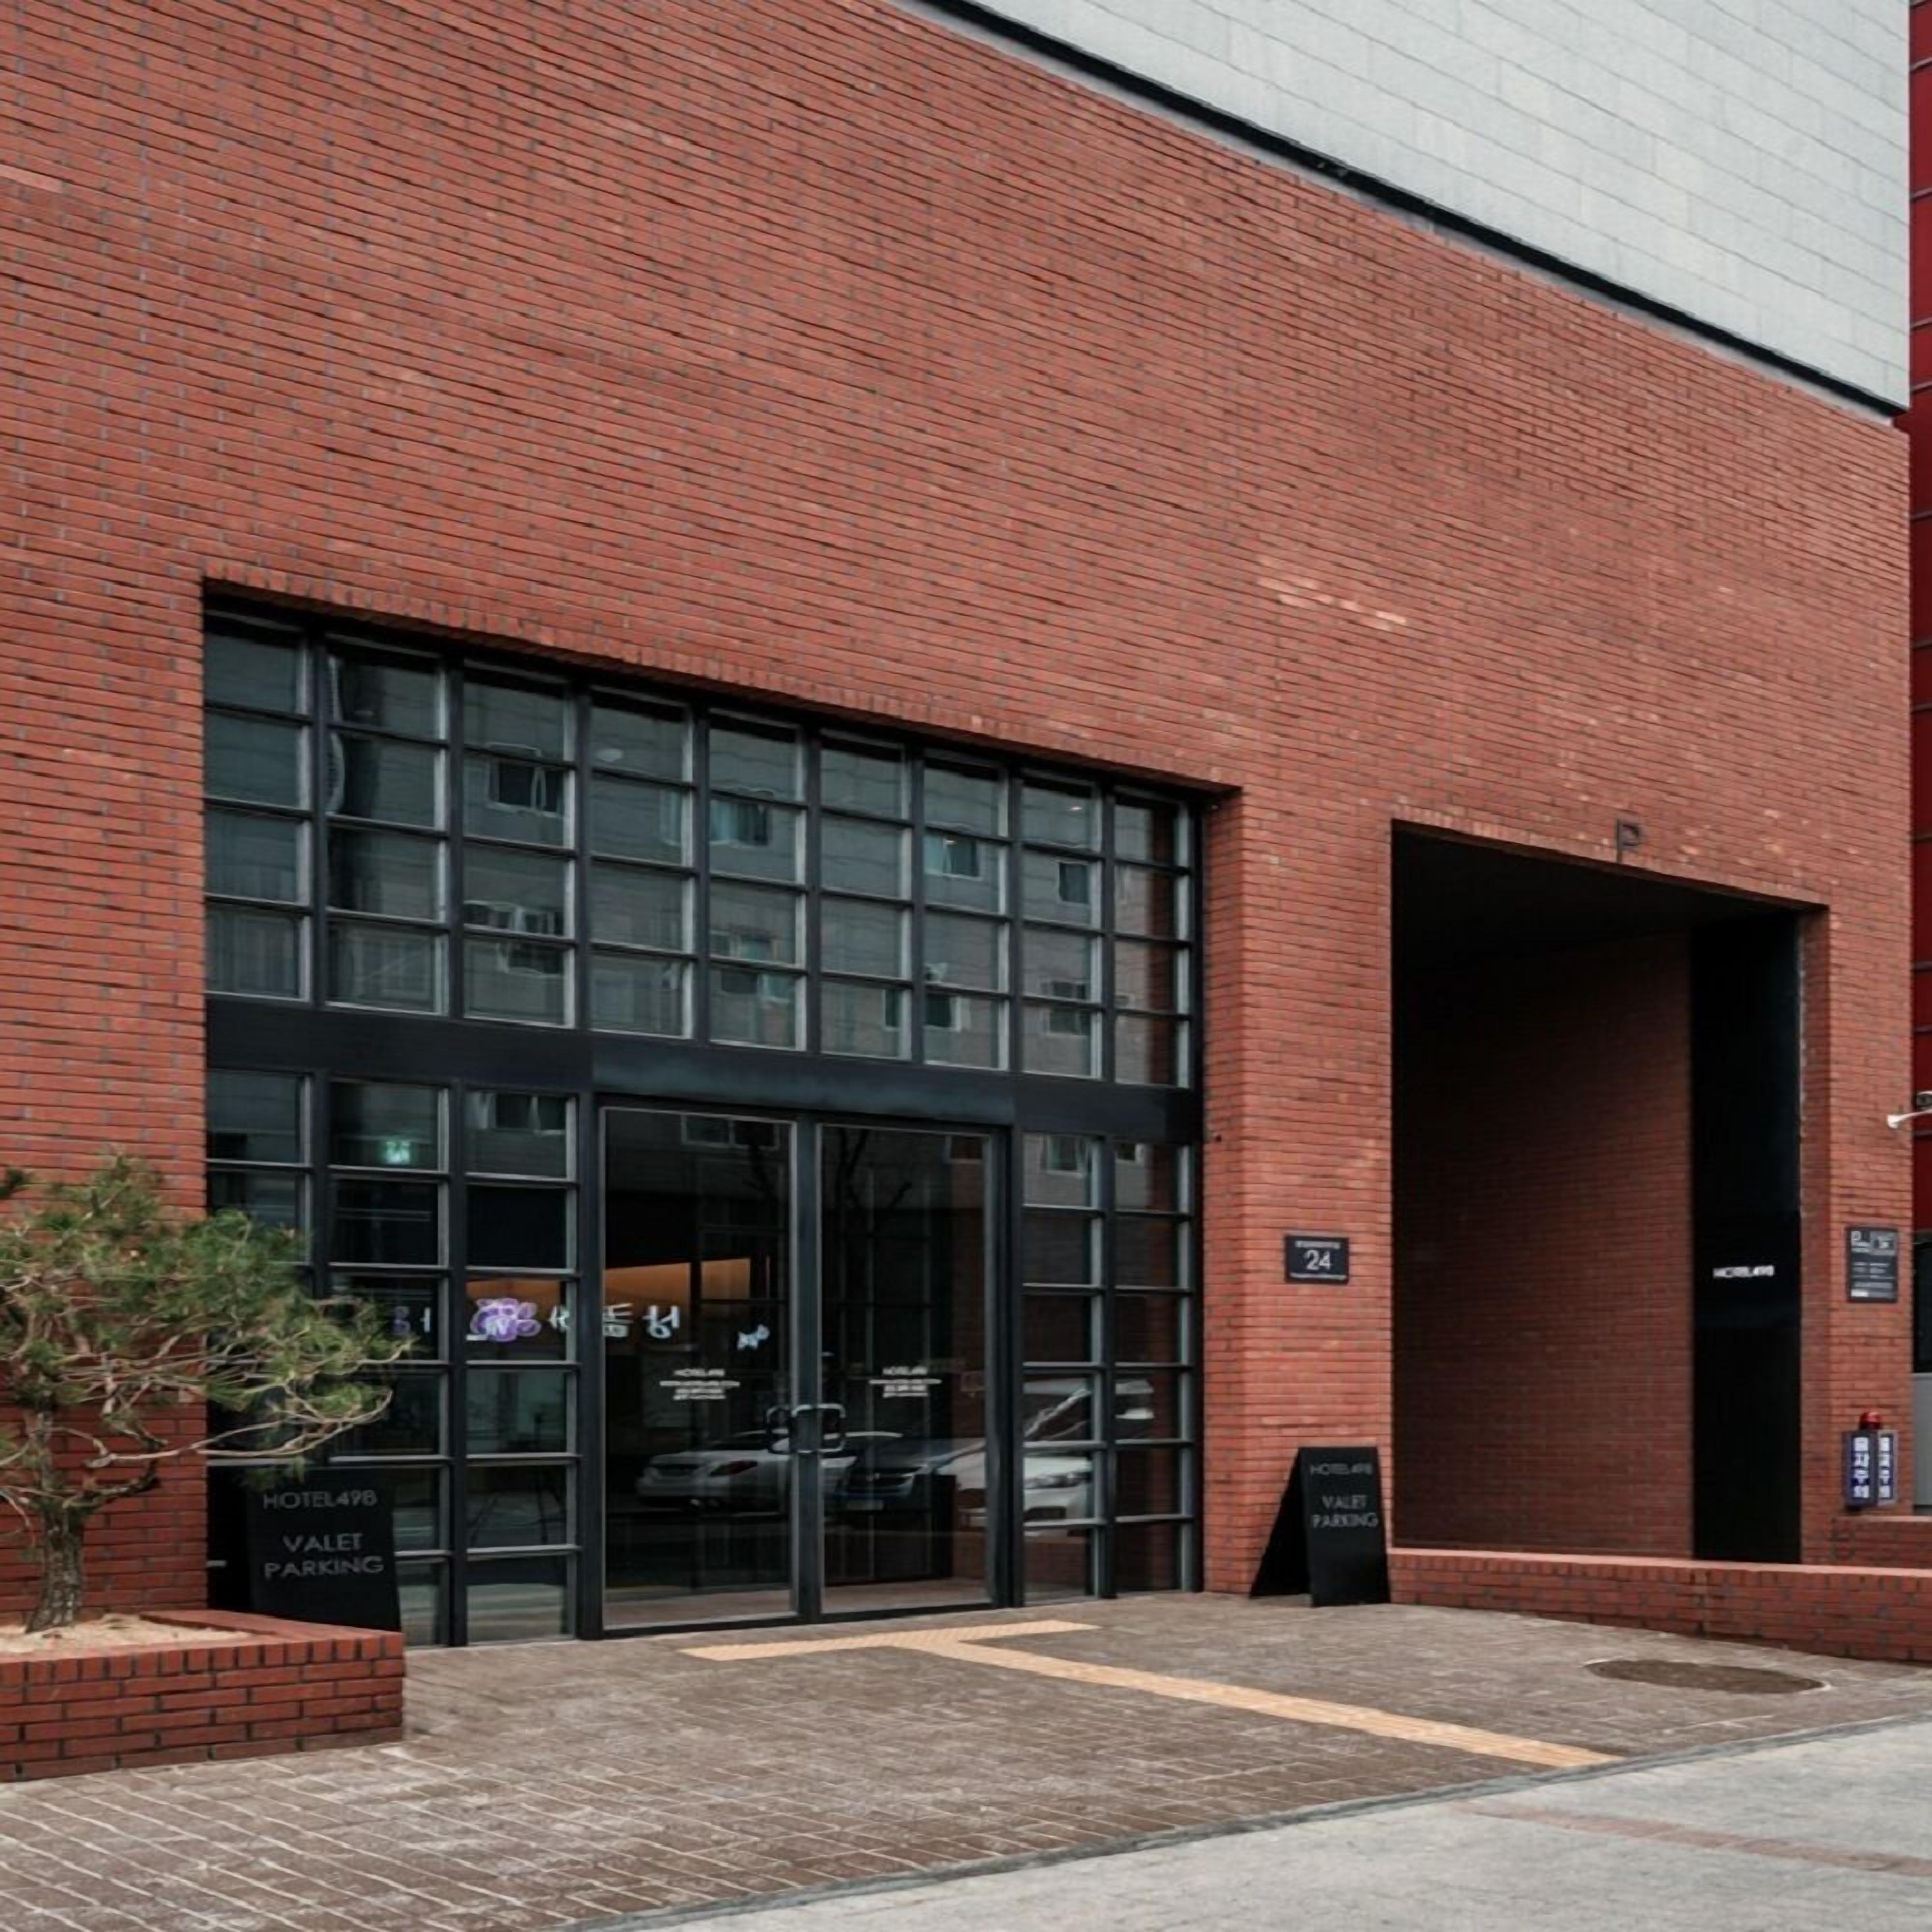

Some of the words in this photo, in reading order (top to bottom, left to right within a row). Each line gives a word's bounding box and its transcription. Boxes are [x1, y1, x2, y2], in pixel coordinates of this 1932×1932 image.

[1304, 1250, 1331, 1271] 24
[263, 1490, 378, 1509] HOTEL498
[1321, 1495, 1367, 1509] VALET
[1312, 1512, 1378, 1528] PARKING
[283, 1533, 363, 1552] VALET
[264, 1556, 384, 1580] PARKING
